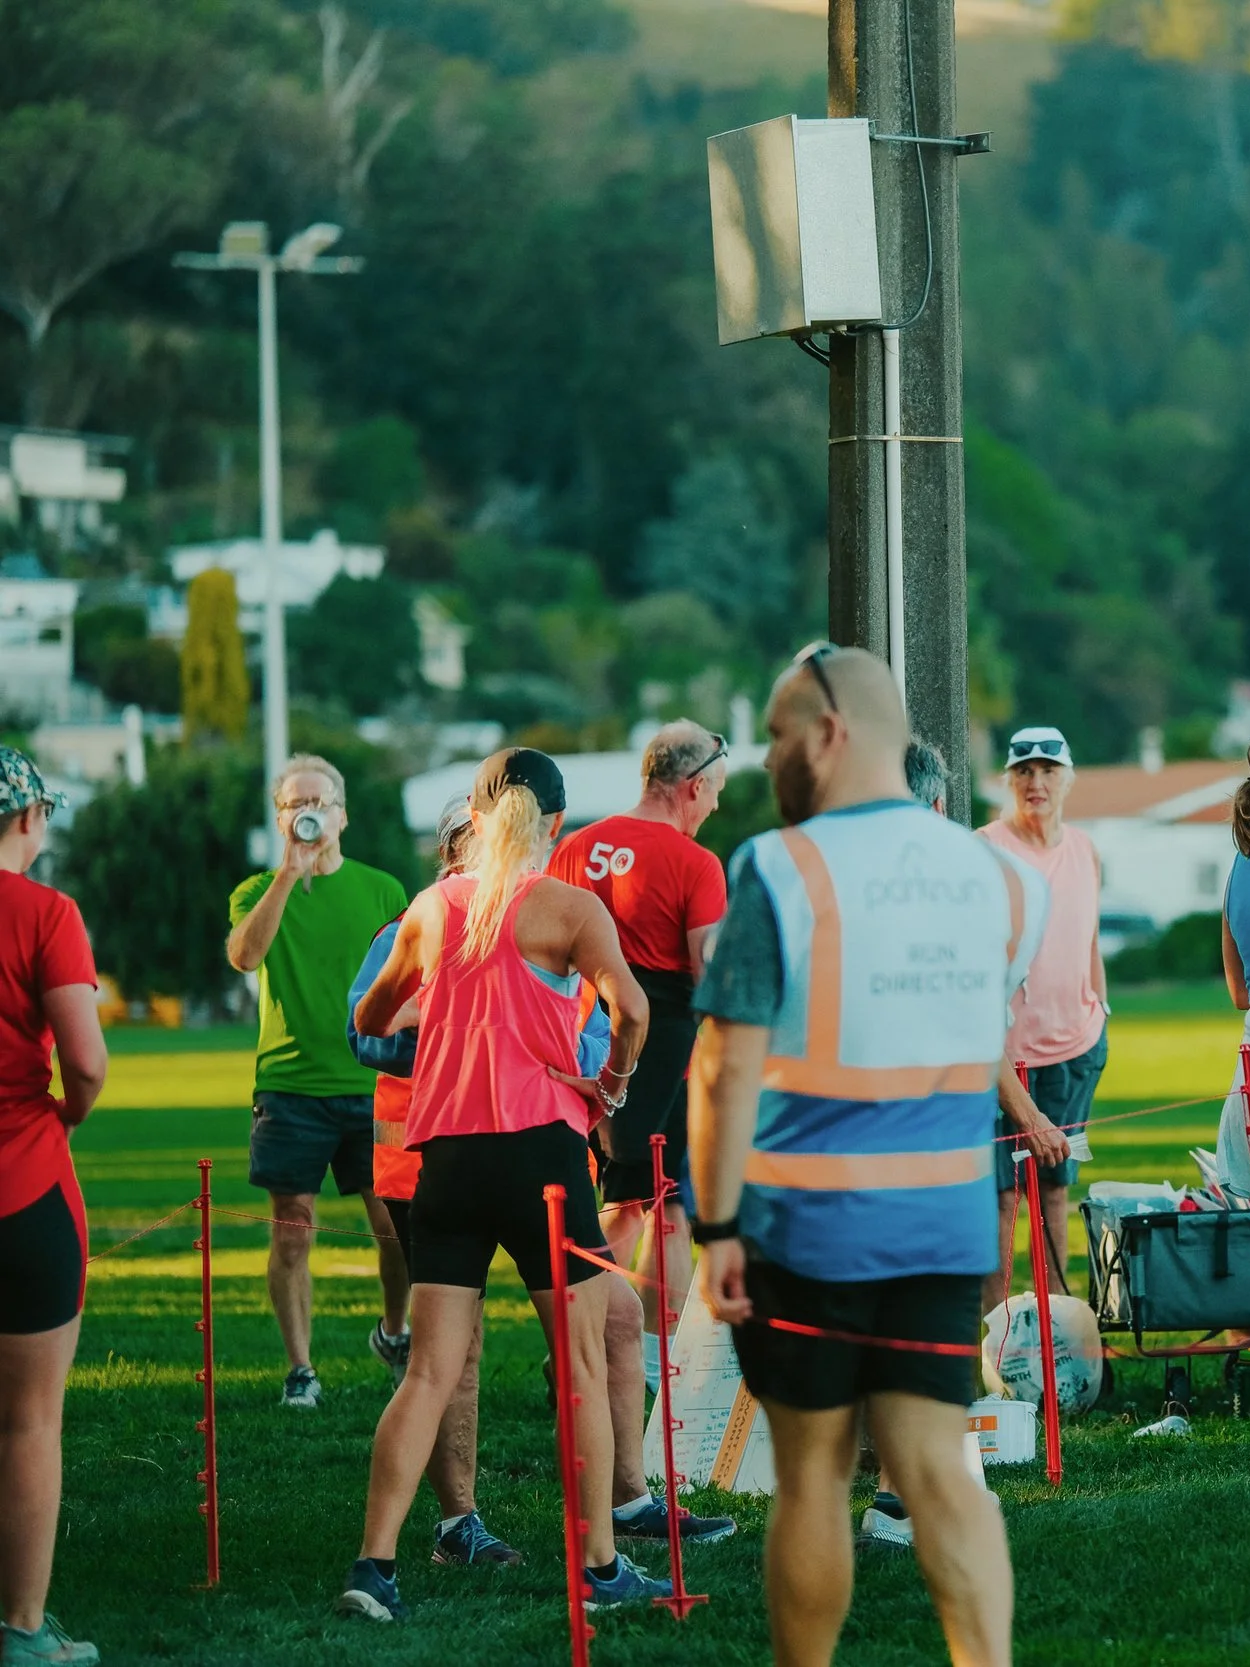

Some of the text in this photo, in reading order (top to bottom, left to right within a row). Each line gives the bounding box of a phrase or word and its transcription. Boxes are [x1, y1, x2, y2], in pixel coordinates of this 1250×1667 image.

[584, 841, 635, 880] 50
[907, 943, 958, 963] RUN
[869, 971, 990, 995] DIRECTOR
[723, 1399, 752, 1478] WANT TO
